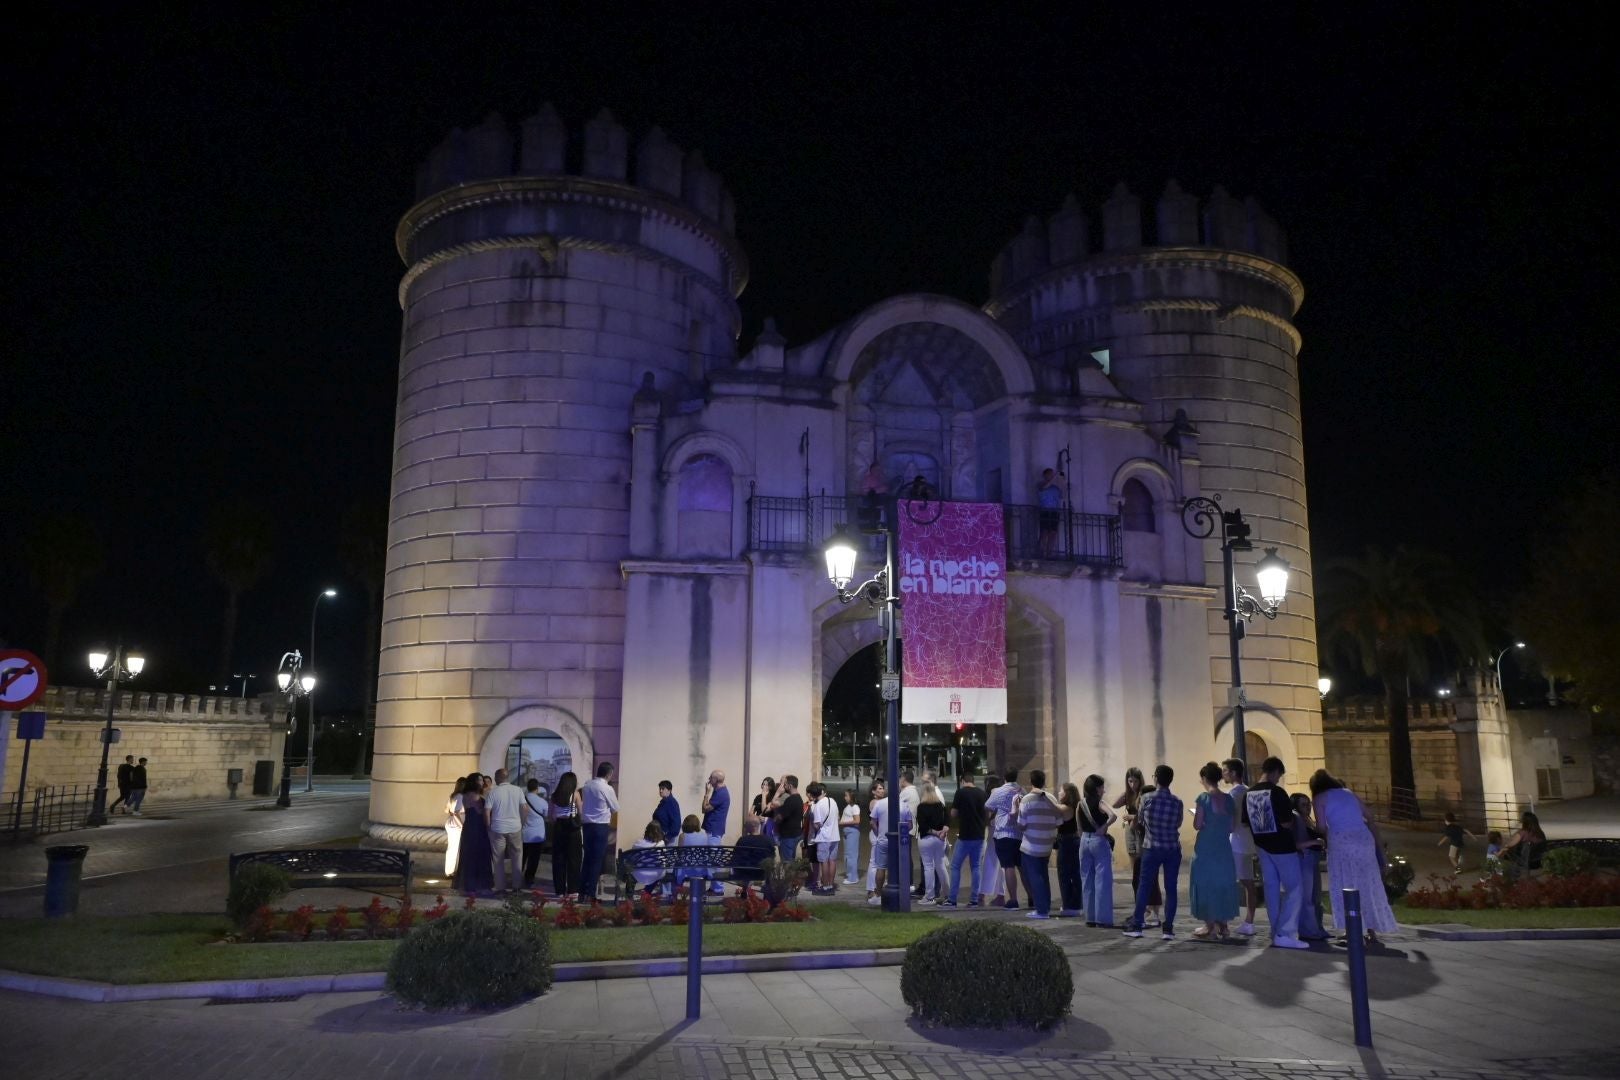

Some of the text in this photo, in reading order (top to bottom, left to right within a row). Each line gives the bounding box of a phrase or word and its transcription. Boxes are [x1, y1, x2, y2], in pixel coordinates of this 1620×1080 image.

[904, 554, 1000, 577] la noche
[899, 576, 1007, 596] en blanco
